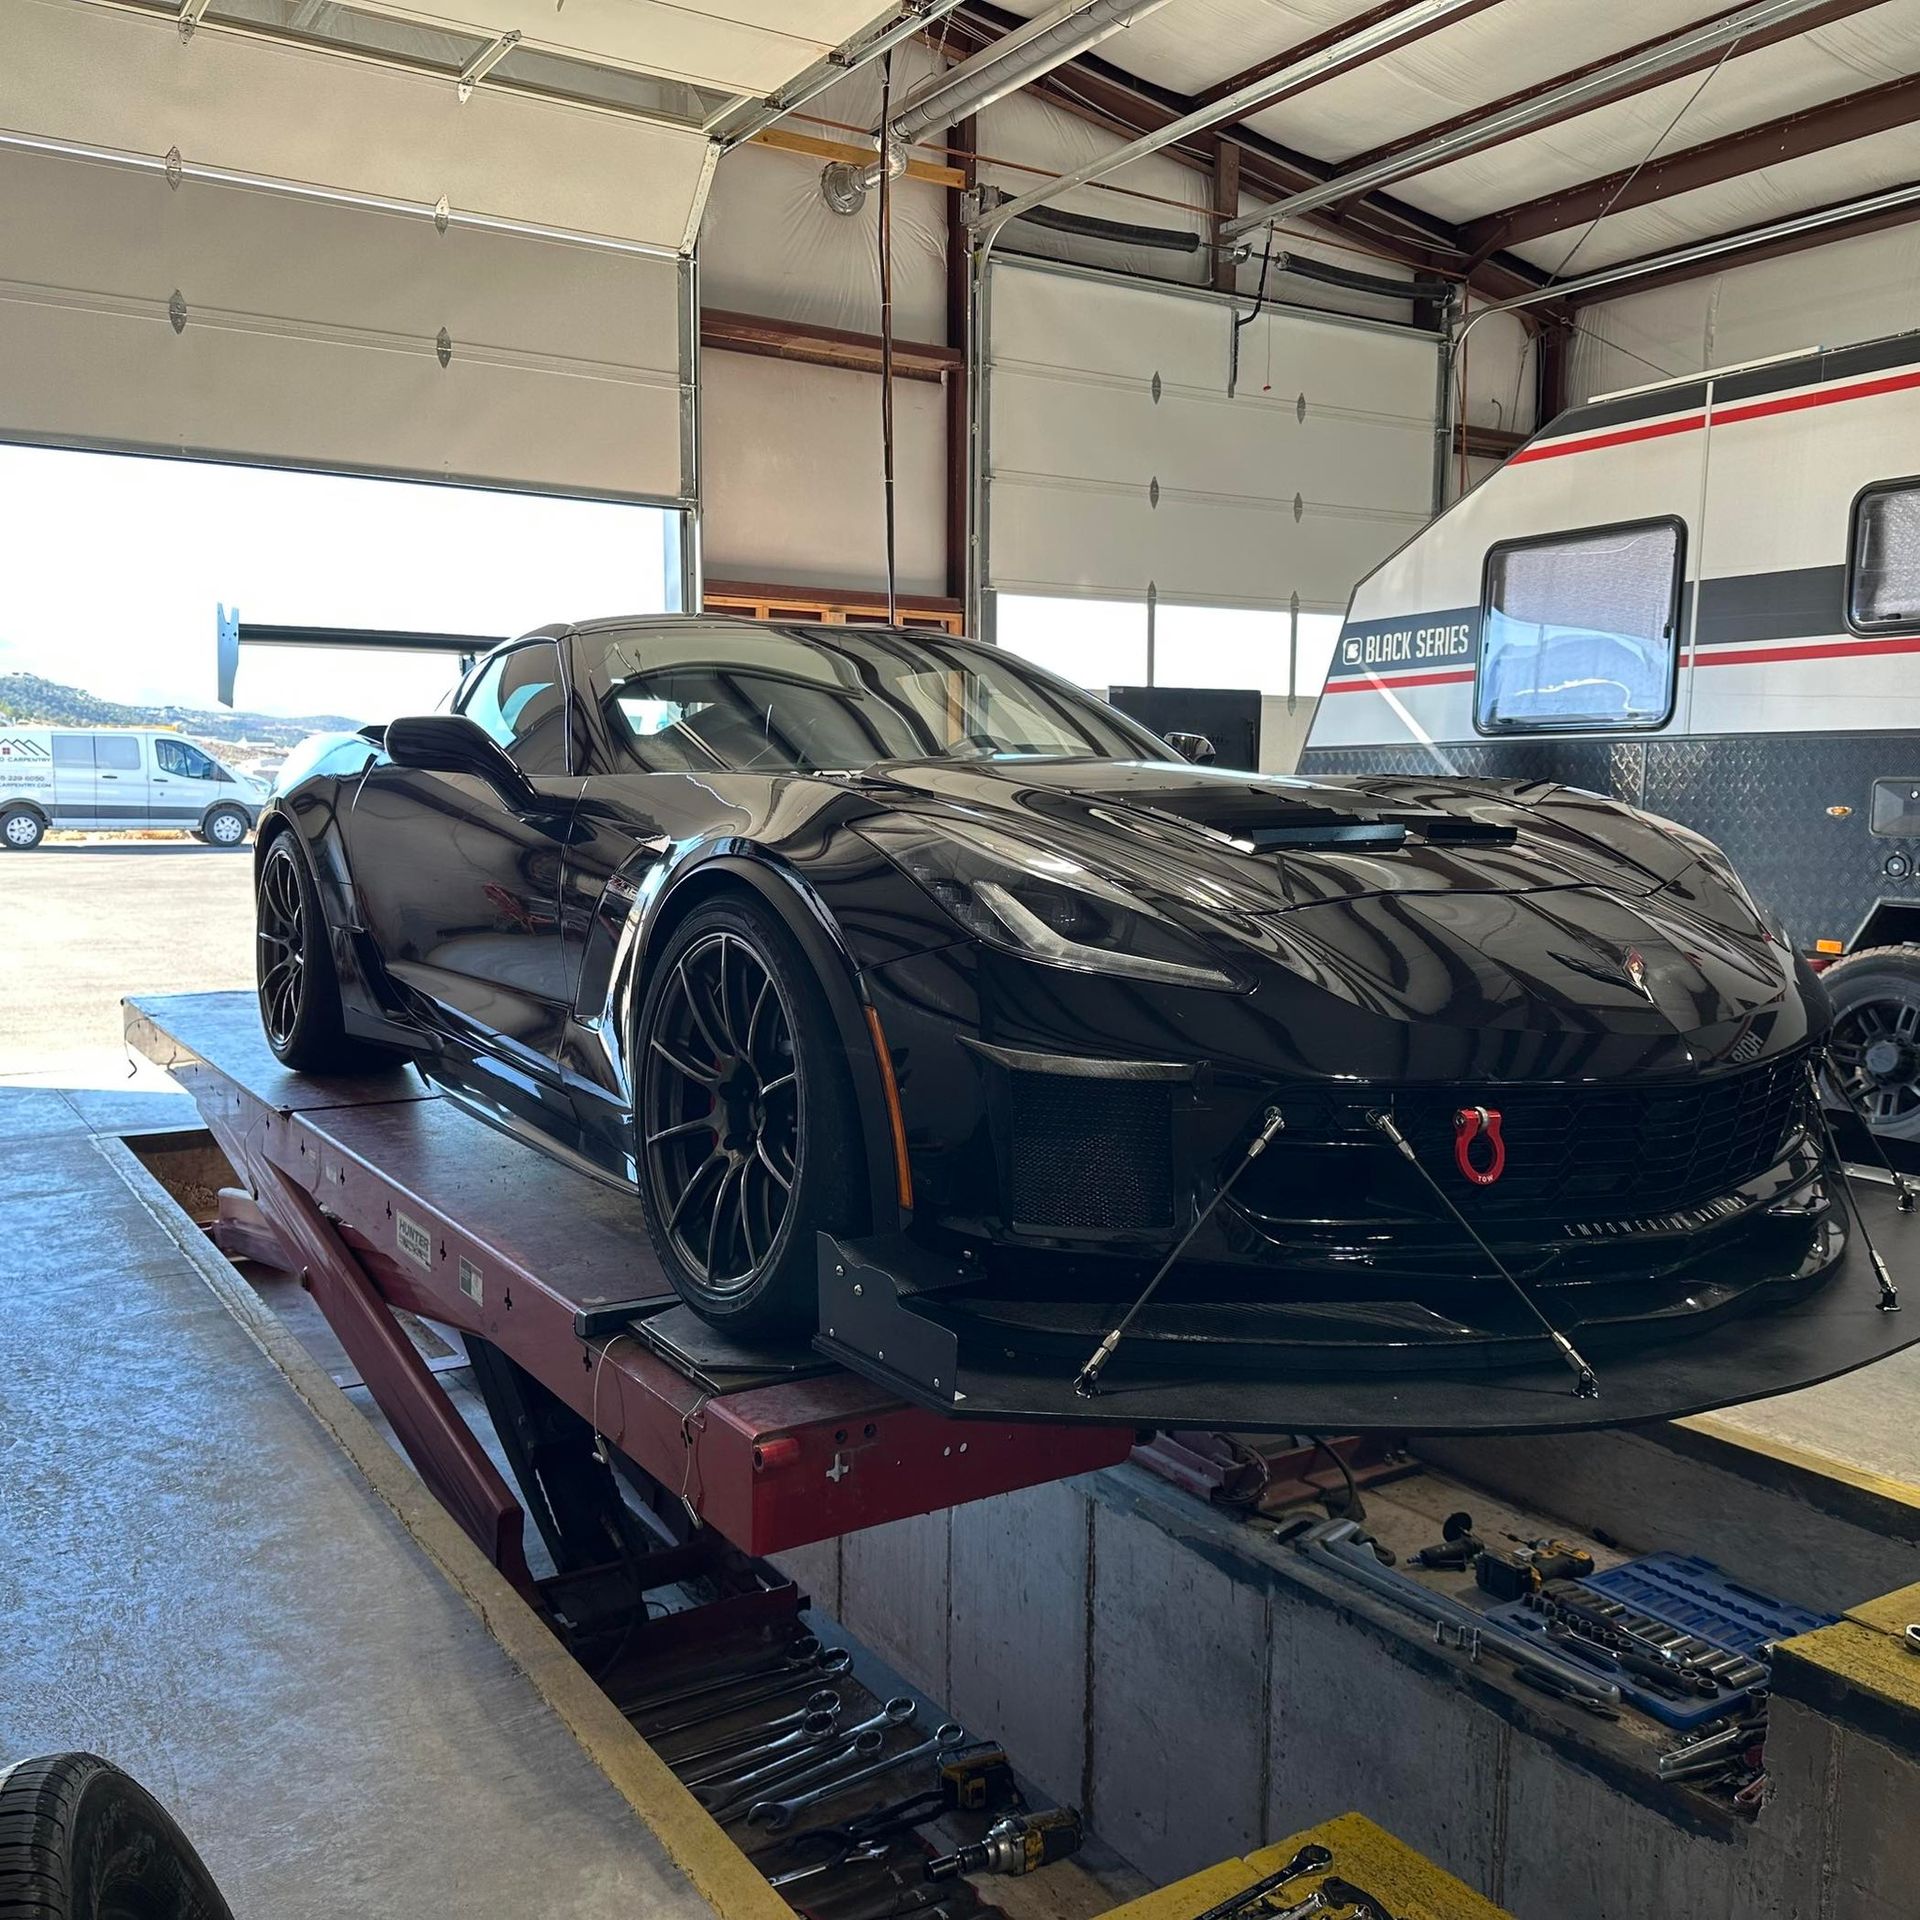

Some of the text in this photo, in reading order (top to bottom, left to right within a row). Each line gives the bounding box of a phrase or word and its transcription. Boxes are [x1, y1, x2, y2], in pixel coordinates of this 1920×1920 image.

[1365, 625, 1469, 663] BLACK SERIES
[1478, 1174, 1494, 1183] TOW
[399, 1219, 429, 1252] HUNTER
[1564, 1214, 1692, 1237] EMPOWERING
